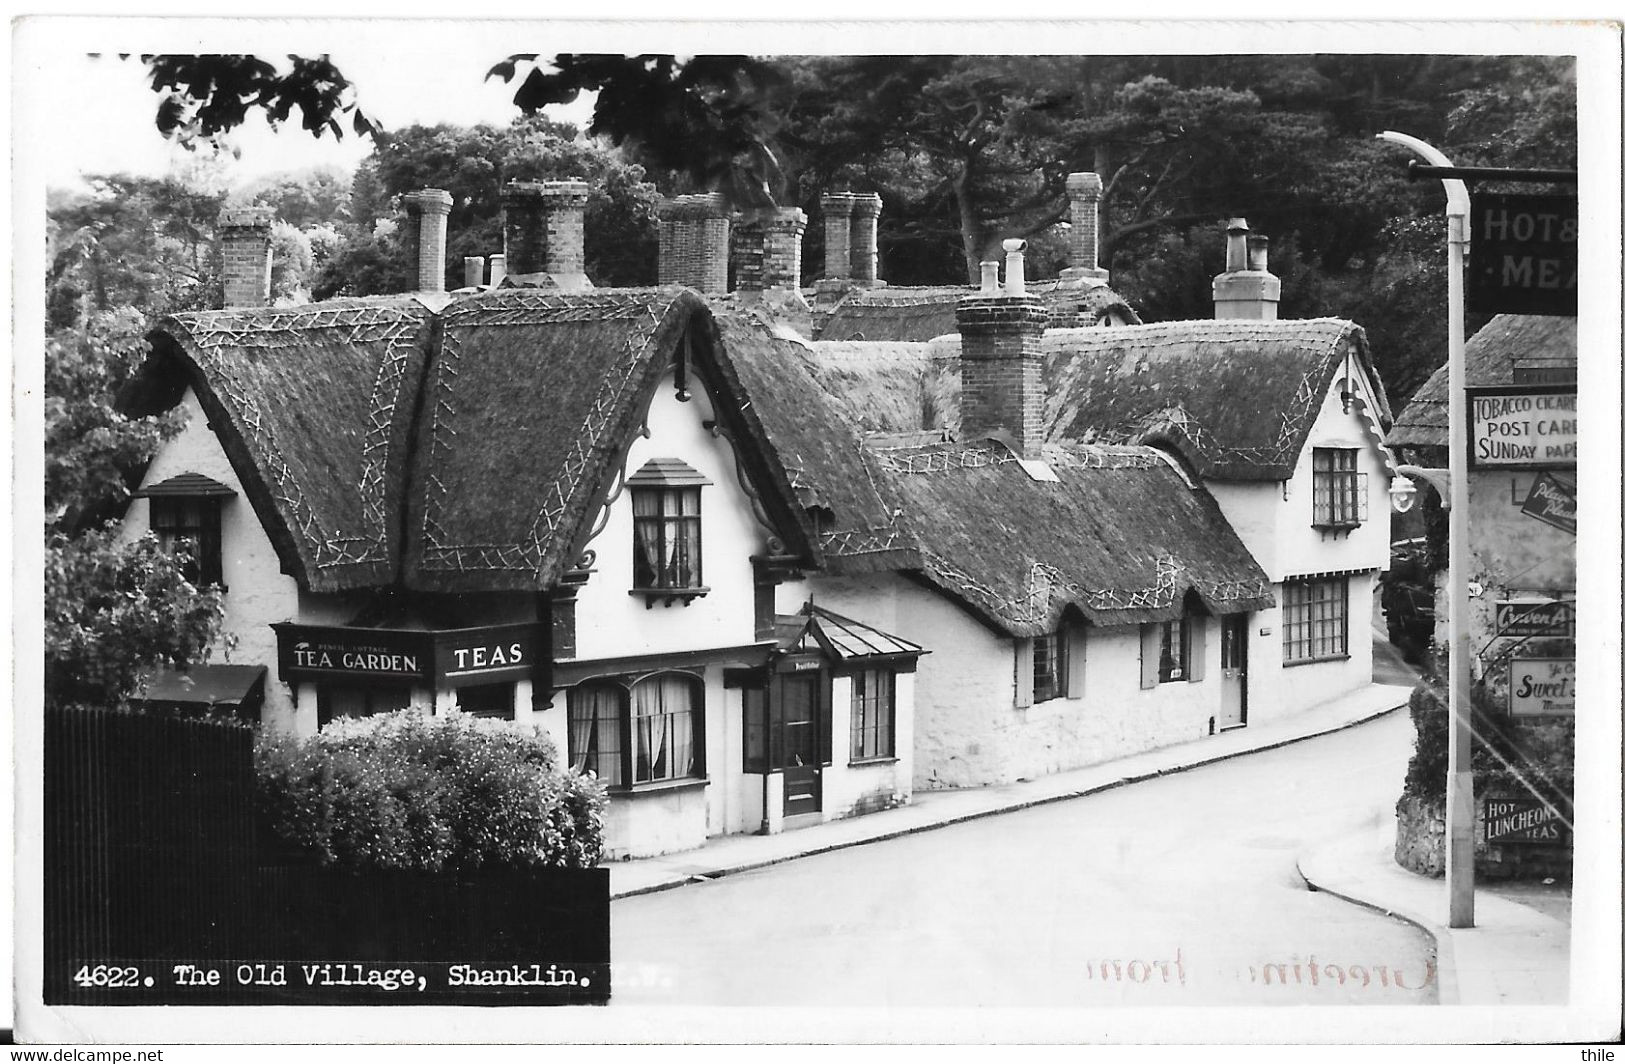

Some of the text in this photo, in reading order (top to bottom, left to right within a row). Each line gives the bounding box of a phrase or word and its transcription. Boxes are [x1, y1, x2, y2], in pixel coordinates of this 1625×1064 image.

[1473, 397, 1531, 424] TOBACCO
[1487, 421, 1530, 437] POST
[1479, 437, 1537, 460] SUNDAY
[1497, 605, 1550, 628] Craven
[294, 650, 420, 672] TEA GARDEN.
[454, 643, 523, 668] TEAS
[1516, 674, 1569, 698] Sweet
[1487, 803, 1560, 840] LUNCHEONS
[1489, 802, 1516, 818] HOT
[1526, 823, 1558, 839] TEAS
